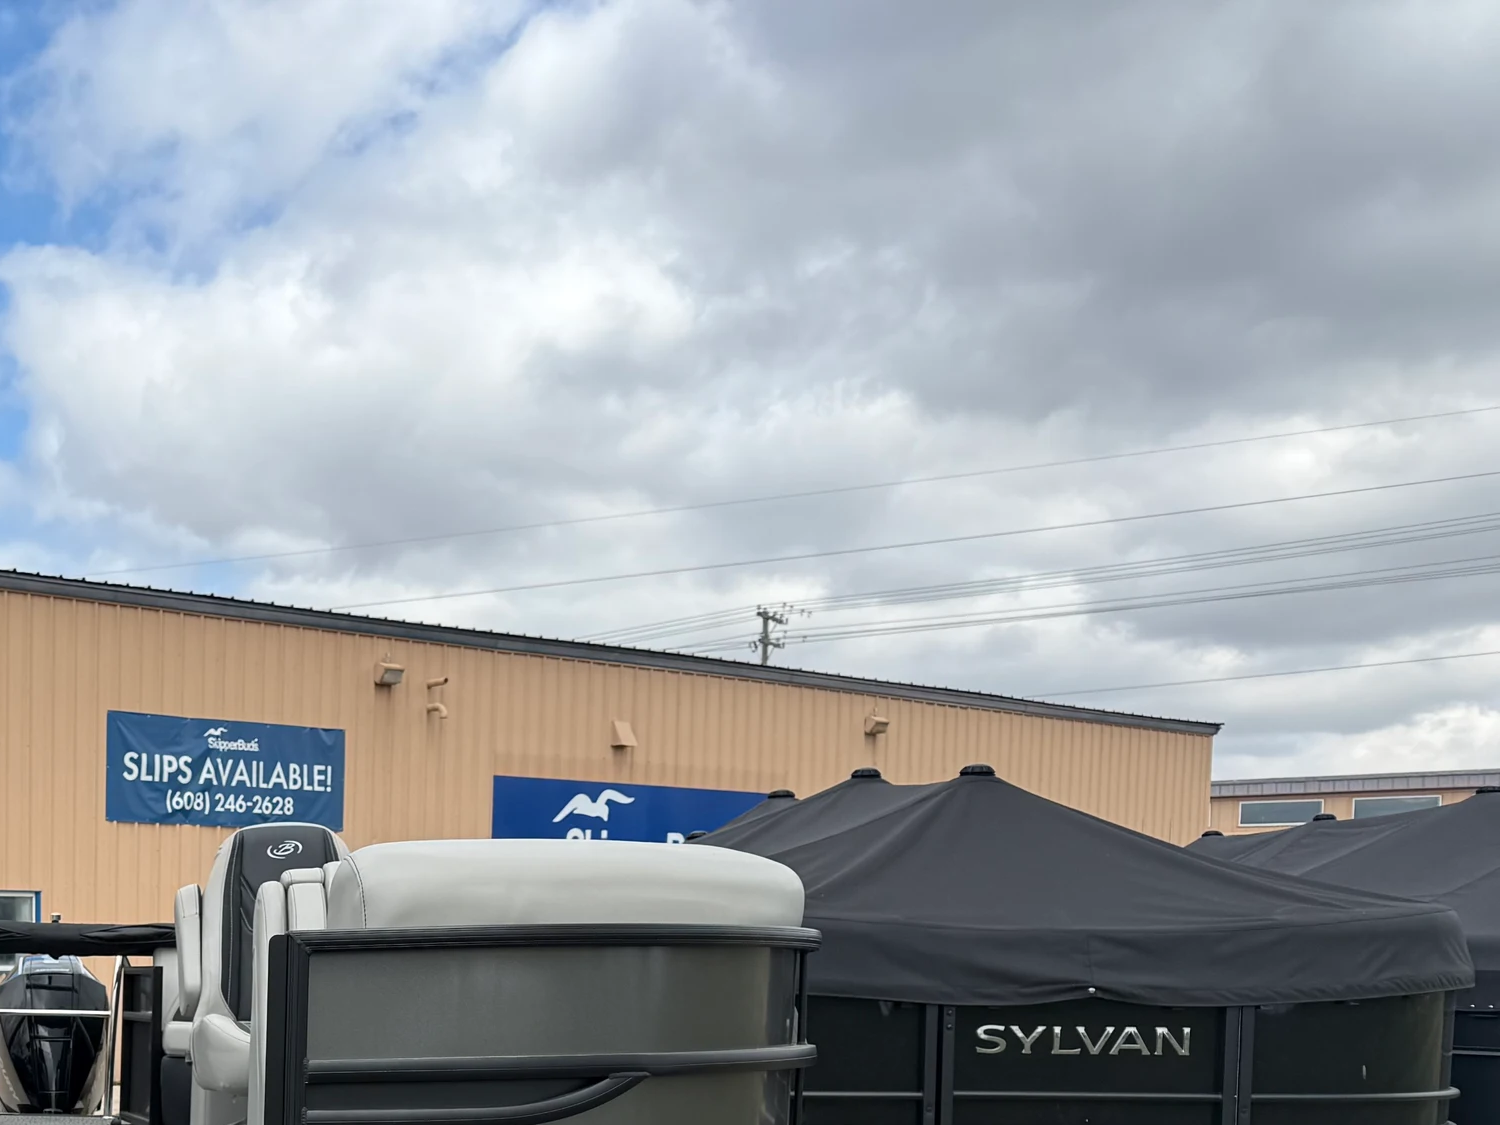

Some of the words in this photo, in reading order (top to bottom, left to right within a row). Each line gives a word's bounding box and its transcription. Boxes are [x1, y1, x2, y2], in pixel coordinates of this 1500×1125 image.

[122, 751, 193, 785] SLIPS
[198, 756, 333, 792] AVAILABLE!
[165, 789, 210, 815] (608)
[214, 793, 295, 816] 246-2628
[975, 1024, 1191, 1057] SYLVAN
